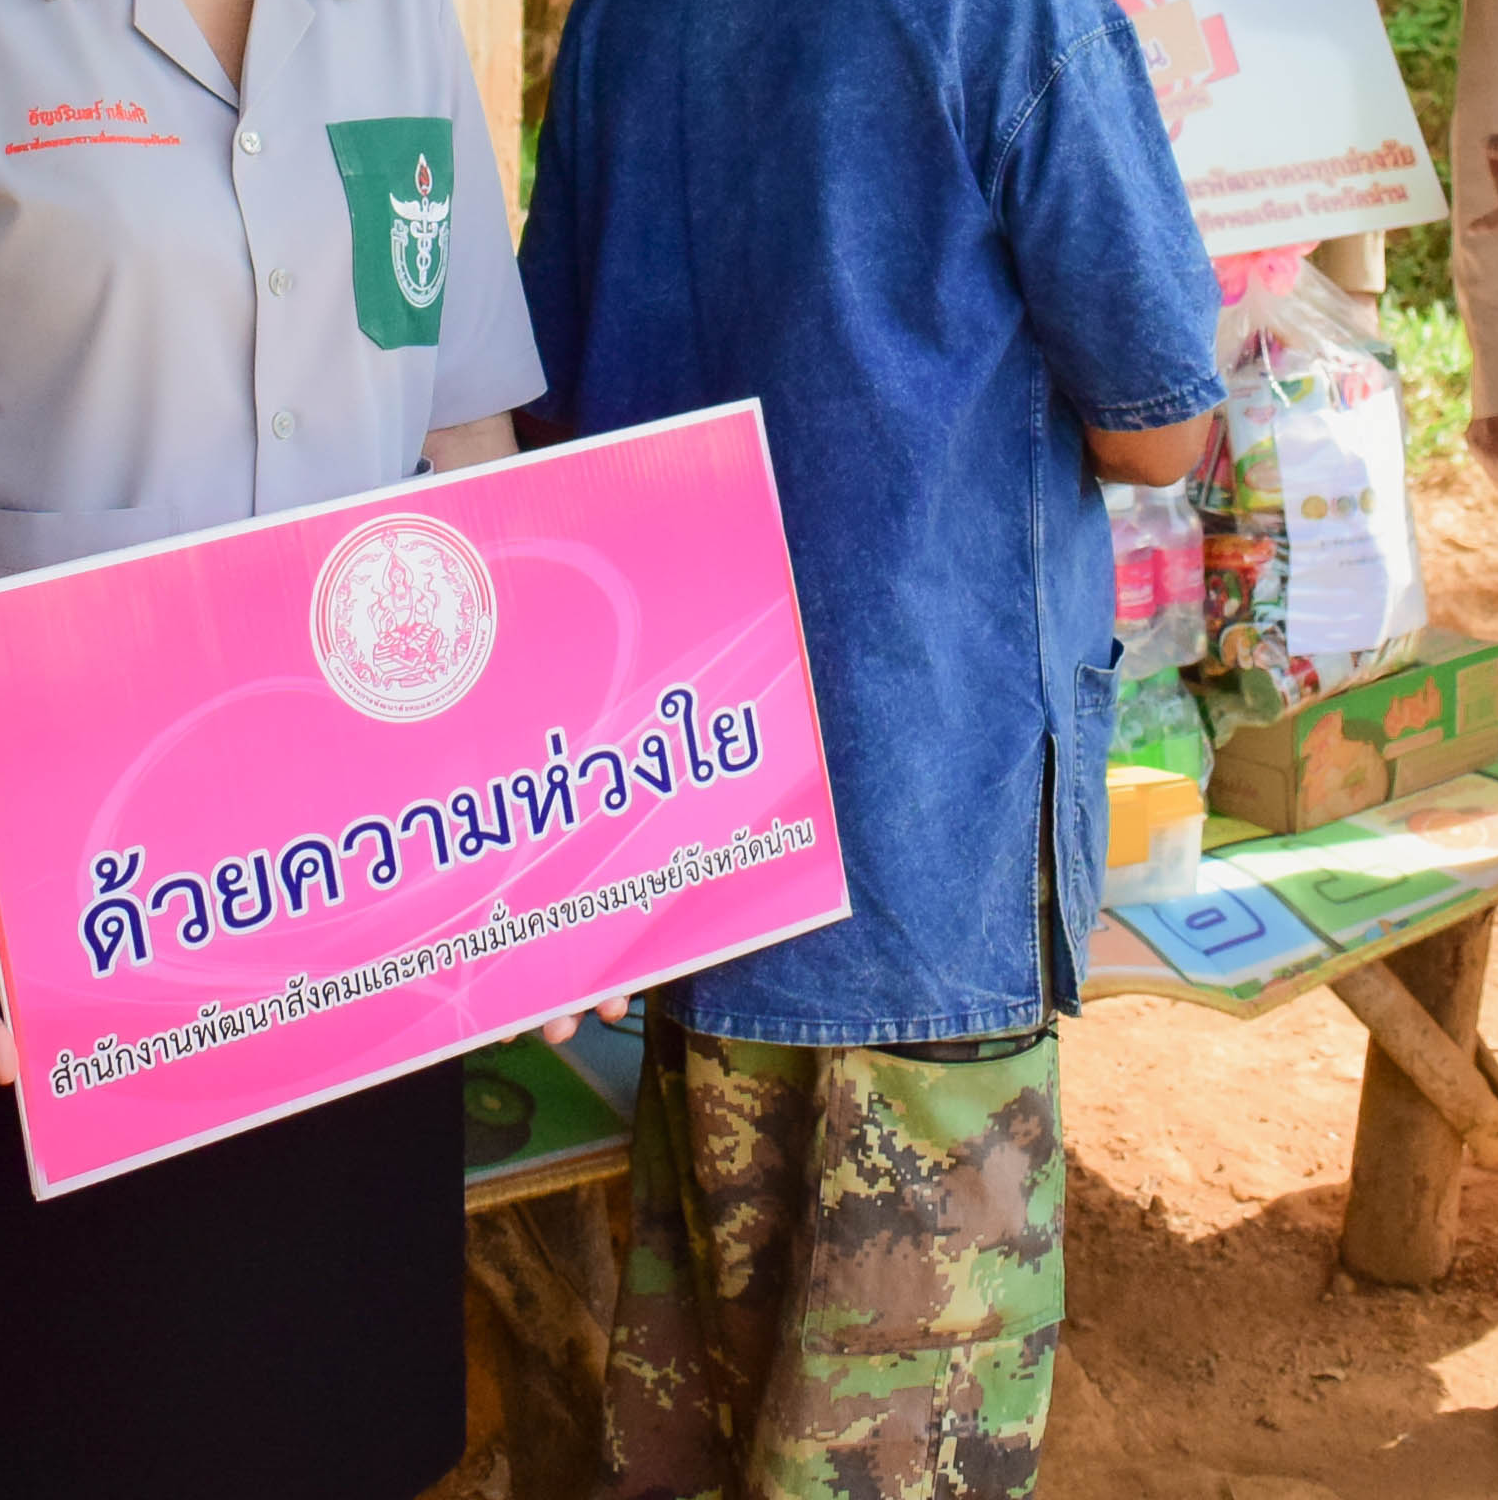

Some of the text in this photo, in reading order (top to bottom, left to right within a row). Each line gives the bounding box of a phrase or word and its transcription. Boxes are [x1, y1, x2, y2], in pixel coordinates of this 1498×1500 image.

[50, 818, 814, 1099] สำนักงานพัฒนาสังคมและความมั่นคงของมนุษย์จังหวัดน่าน
[81, 684, 762, 975] ด้วยความห่วงใย
